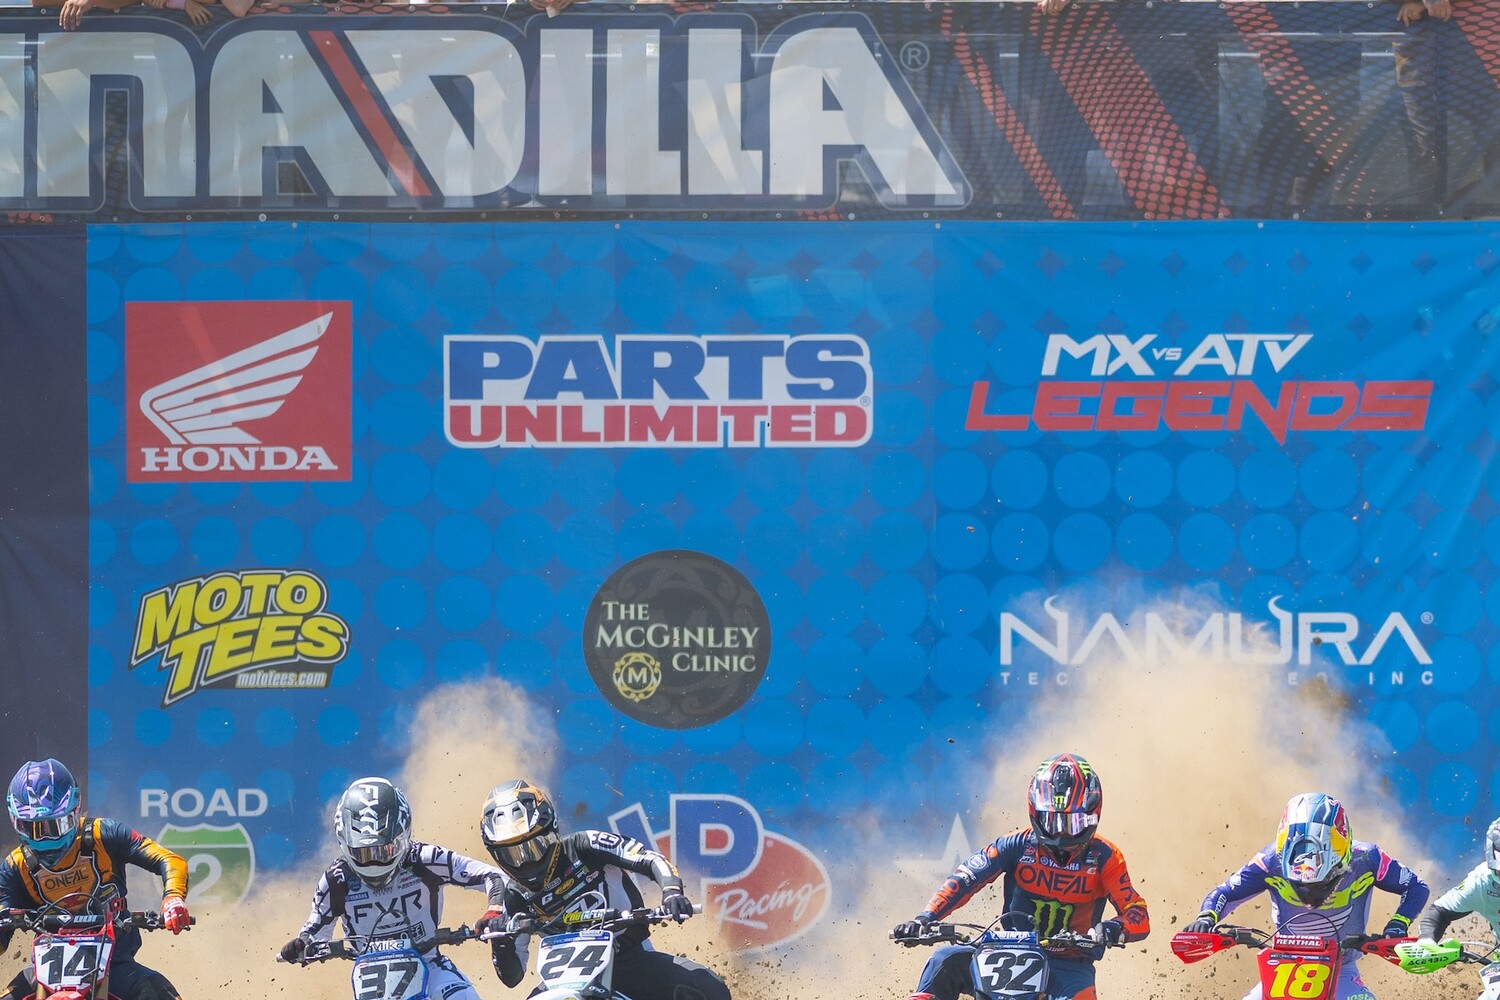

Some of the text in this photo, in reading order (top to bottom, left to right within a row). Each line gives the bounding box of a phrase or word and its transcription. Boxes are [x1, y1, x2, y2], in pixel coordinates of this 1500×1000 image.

[0, 28, 966, 198] NADILLA
[449, 339, 868, 401] PARTS
[1041, 334, 1158, 376] MX
[1179, 334, 1313, 376] ATV
[447, 404, 870, 444] UNLIMITED
[964, 381, 1434, 446] LEGENDS
[141, 445, 338, 472] HONDA
[136, 574, 322, 656] MOTO
[602, 601, 649, 620] THE
[1000, 594, 1433, 665] NAMURA
[167, 615, 344, 696] TEES
[672, 652, 756, 672] CLINIC
[236, 669, 327, 688] mototees.com
[1369, 672, 1433, 685] INC
[140, 788, 267, 817] ROAD
[358, 784, 379, 836] FXR
[353, 889, 423, 924] FXR
[715, 878, 828, 930] Racing
[1276, 938, 1321, 947] RENTHAL
[1407, 956, 1450, 966] ACERBIS
[41, 945, 99, 985] 14
[358, 961, 418, 1000] 37
[540, 944, 608, 981] 24
[981, 951, 1044, 992] 32
[1269, 963, 1331, 999] 18
